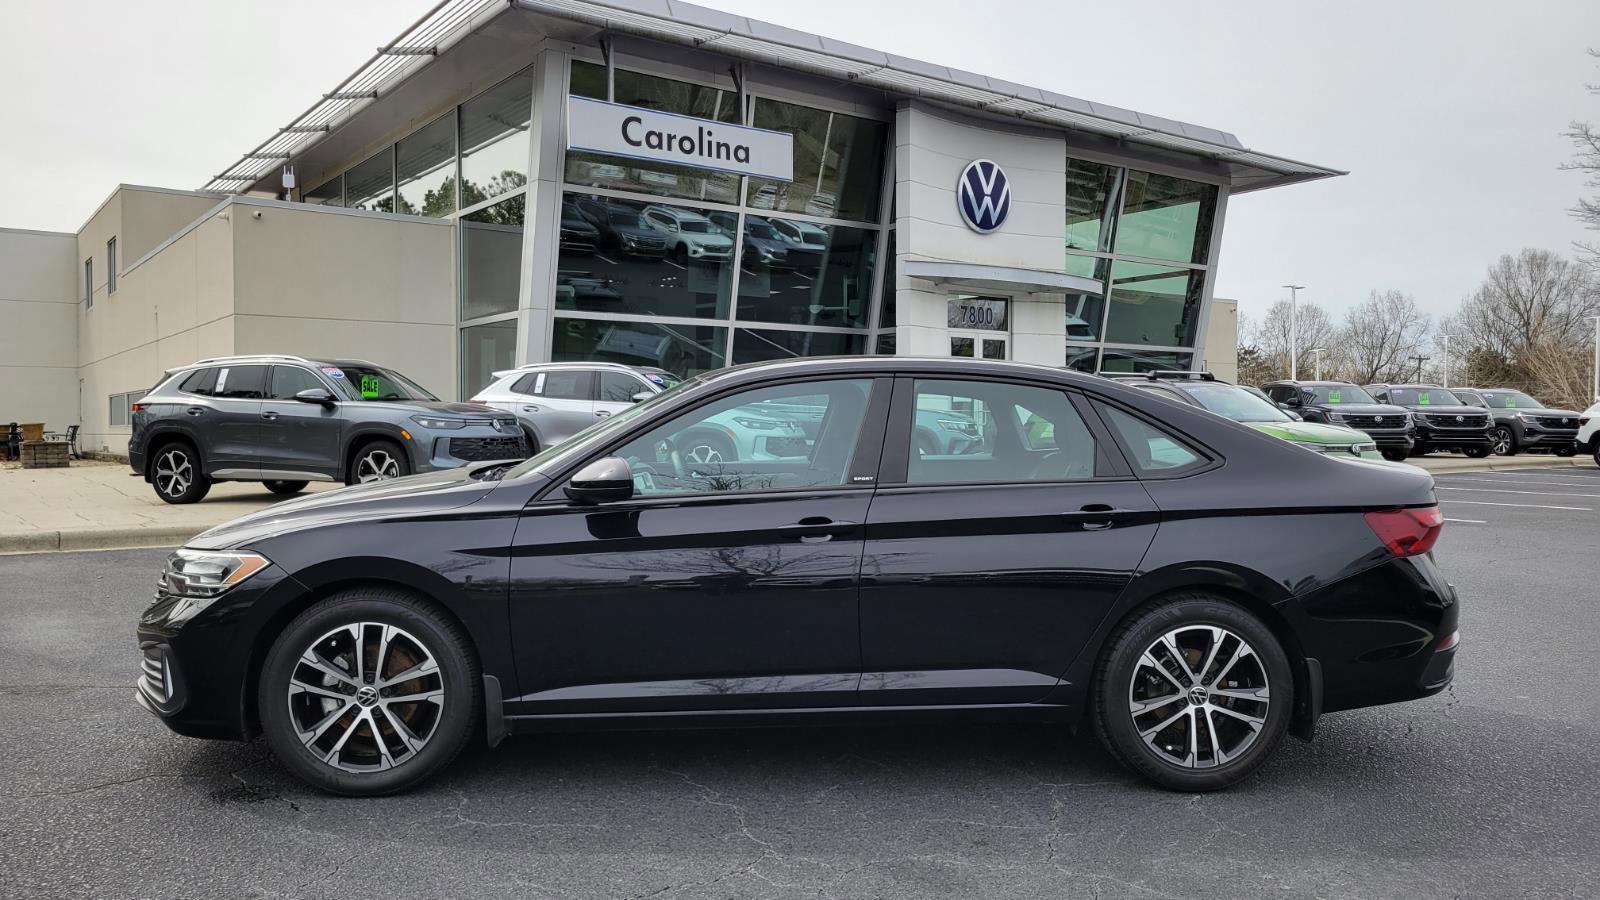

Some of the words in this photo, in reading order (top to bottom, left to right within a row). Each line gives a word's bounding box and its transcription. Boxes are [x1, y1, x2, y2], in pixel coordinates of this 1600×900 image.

[621, 115, 750, 163] Carolina
[959, 160, 1010, 228] VW
[960, 305, 993, 325] 7800
[362, 381, 378, 393] SALE
